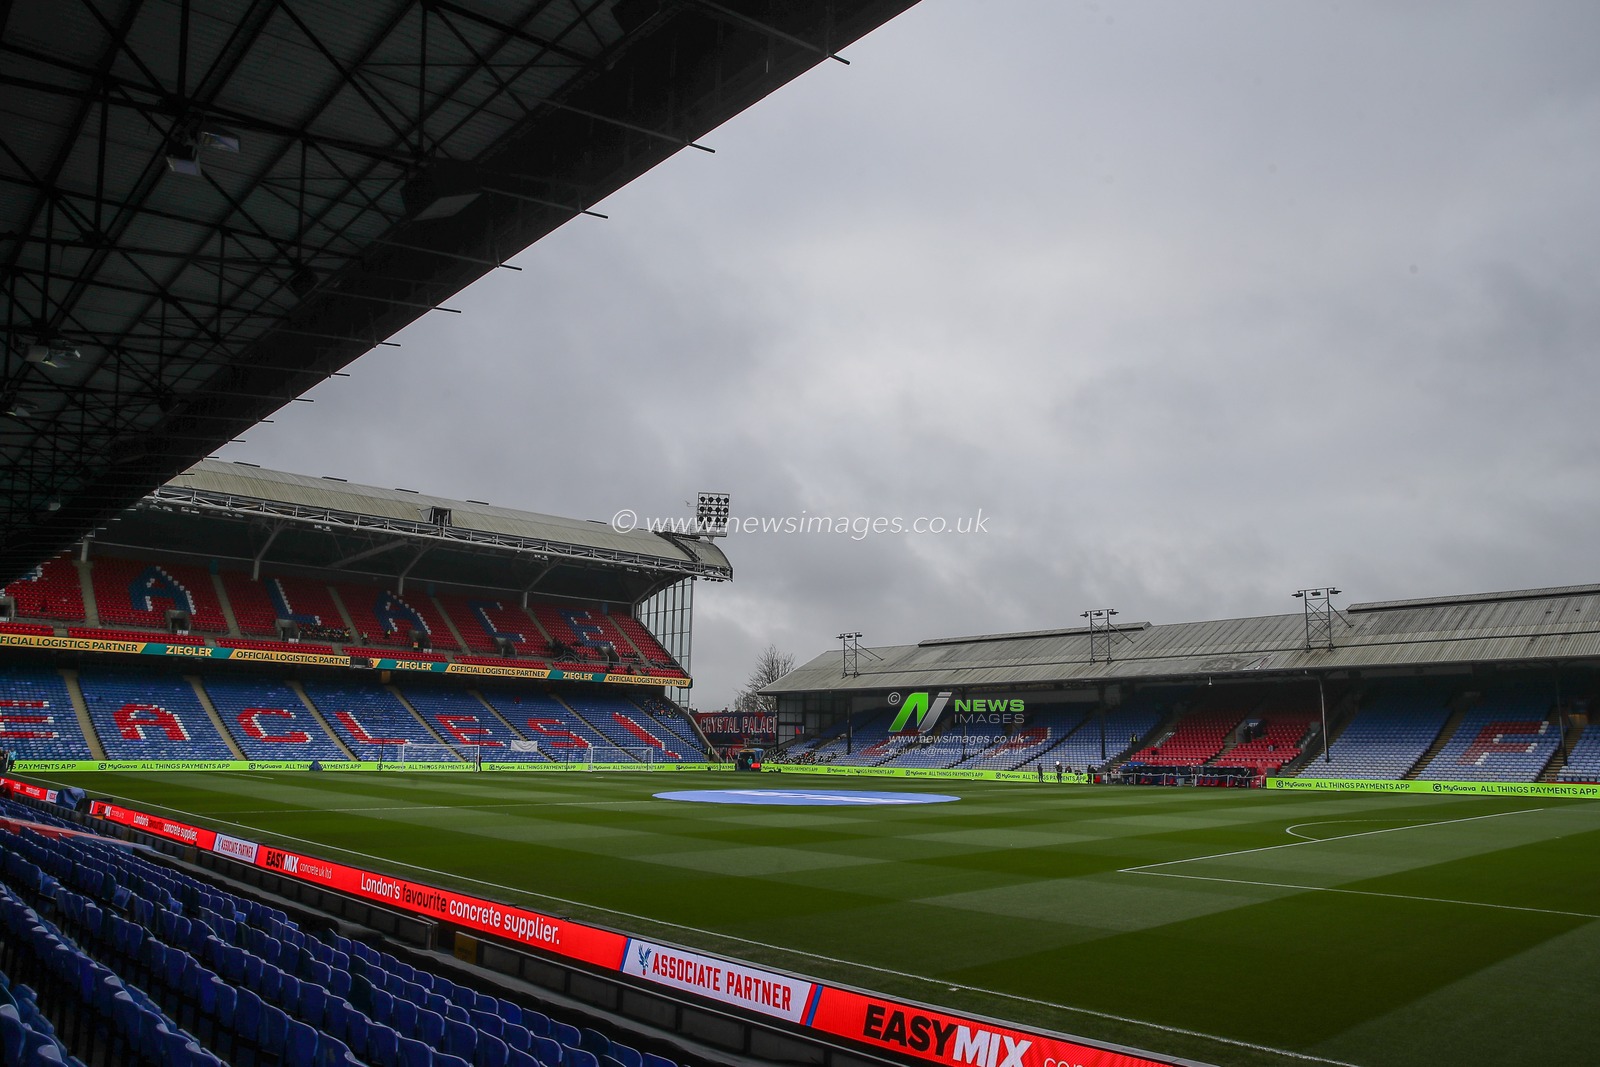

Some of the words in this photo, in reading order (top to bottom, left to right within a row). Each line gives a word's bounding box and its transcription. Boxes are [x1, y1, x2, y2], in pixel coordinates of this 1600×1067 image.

[37, 638, 90, 649] LOGISTICS
[92, 642, 138, 652] PARTNER
[166, 645, 213, 657] ZIEGLER
[236, 651, 274, 661] OFFICIAL
[276, 653, 317, 664] LOGISTICS
[319, 656, 350, 666] PARTNE
[395, 660, 432, 671] ZIEGLER
[451, 665, 481, 674] OFFICIAL
[482, 667, 515, 676] LOGISTICS
[516, 670, 546, 678] PARTNER
[563, 671, 592, 681] ZIEGLER
[608, 675, 633, 683] OFFICIAL
[634, 676, 661, 685] LOGISTICS
[662, 678, 687, 686] PARTNER
[700, 716, 740, 734] CRYSTAL
[1530, 786, 1577, 795] PAYMENTS
[221, 839, 239, 855] ASSOCIATE
[238, 843, 254, 859] PARTNER
[265, 851, 299, 873] EASYMIX
[300, 862, 318, 876] concrete
[319, 865, 325, 877] uk
[325, 866, 333, 879] ltd
[361, 873, 400, 900] London's
[402, 884, 447, 913] favourite
[450, 899, 501, 928] concrete
[504, 912, 560, 945] supplier.
[652, 953, 721, 992] ASSOCIATE
[726, 971, 792, 1012] PARTNER
